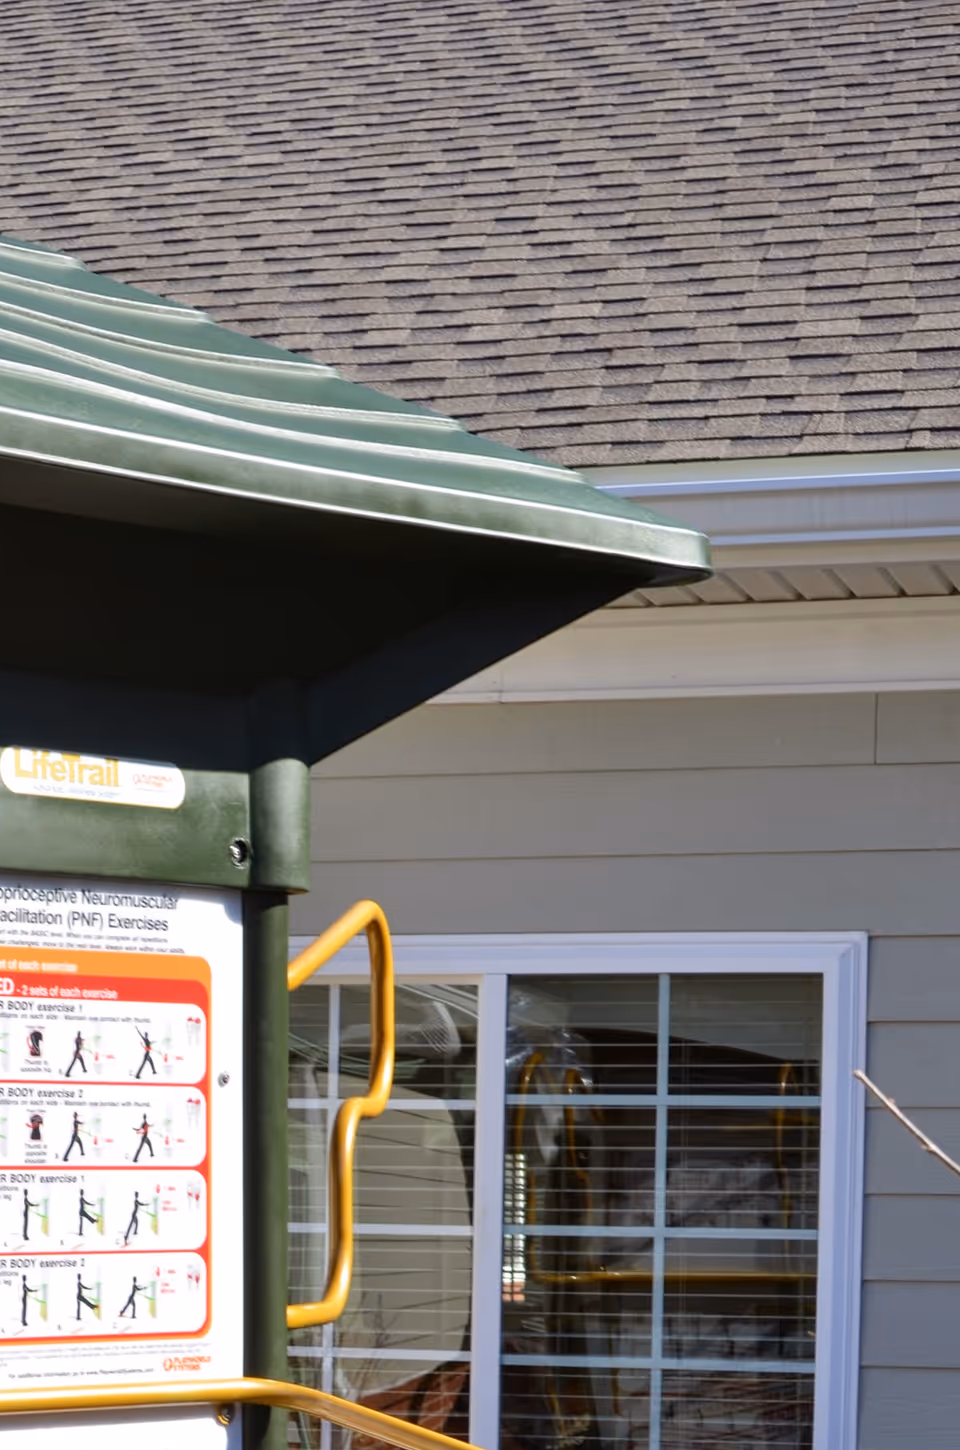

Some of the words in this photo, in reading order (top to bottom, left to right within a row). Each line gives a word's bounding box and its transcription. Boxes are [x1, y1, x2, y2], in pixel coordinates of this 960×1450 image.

[14, 747, 118, 787] LifeTrail
[82, 890, 178, 909] Neuromuscular
[67, 911, 103, 930] (PNF)
[109, 914, 168, 931] Exercises
[8, 960, 16, 969] of
[19, 960, 38, 970] each
[22, 985, 28, 996] 2
[29, 986, 47, 997] sets
[49, 986, 58, 997] of
[60, 987, 81, 998] each
[82, 989, 118, 999] exercise
[8, 1000, 33, 1011] BODY
[37, 1002, 75, 1012] exercise
[8, 1088, 34, 1097] BODY
[37, 1089, 75, 1099] exercise
[10, 1174, 35, 1184] BODY
[40, 1174, 77, 1184] exercise
[10, 1259, 36, 1268] BODY
[40, 1258, 78, 1268] exercise
